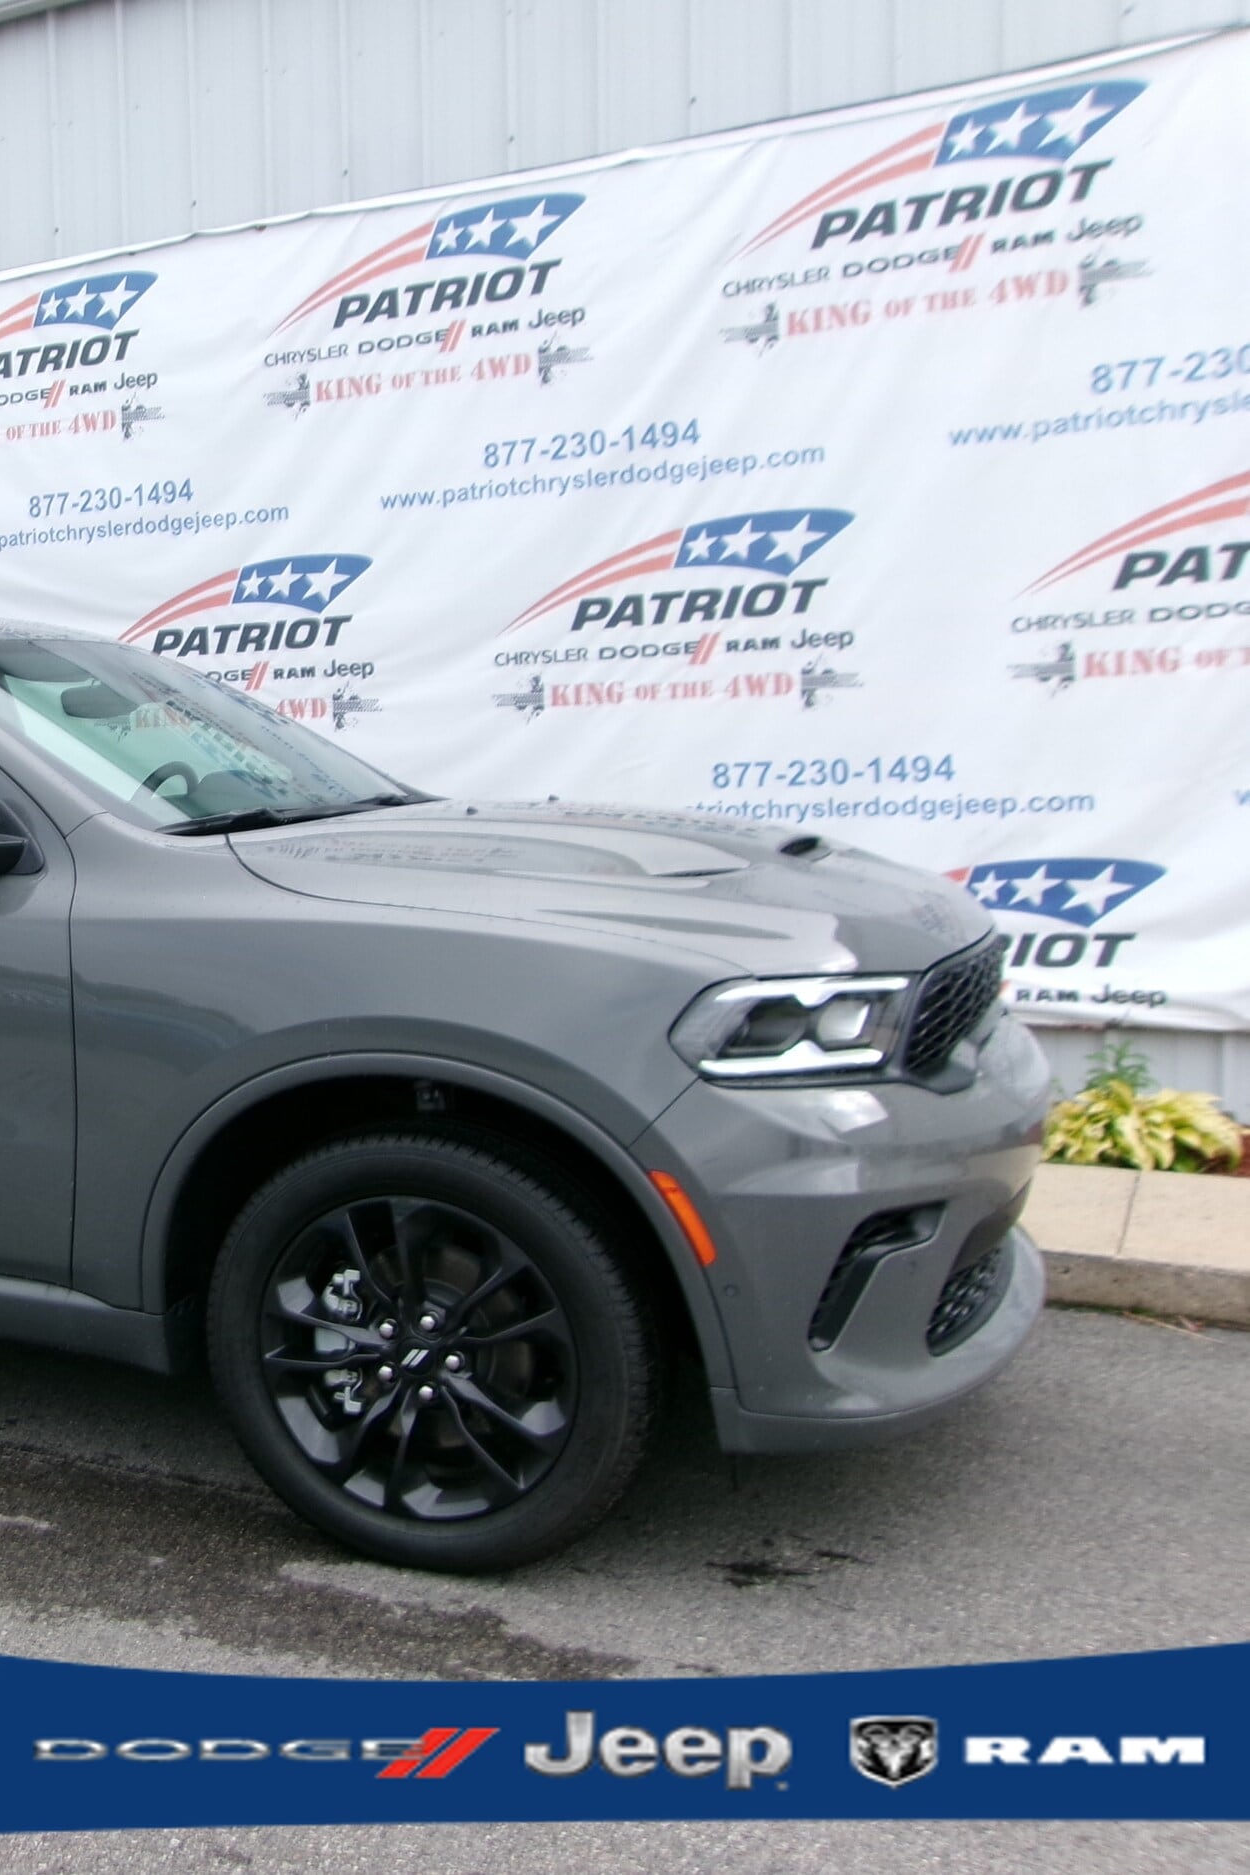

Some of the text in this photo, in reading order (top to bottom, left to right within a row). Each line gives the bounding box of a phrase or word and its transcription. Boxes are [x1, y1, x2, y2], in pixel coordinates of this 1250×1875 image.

[810, 158, 1115, 251] PATRIOT
[722, 213, 1143, 298] CHRYSLER DODGE RAM Jeep
[332, 258, 563, 329] PATRIOT
[786, 270, 1069, 337] KING OF THE 4WD
[264, 306, 586, 368] CHRYSLER DODGE RAM Jeep
[69, 380, 107, 397] RAM
[113, 370, 159, 392] Jeep
[315, 353, 532, 403] KING OF THE 4WD
[1090, 342, 1250, 395] 877-230
[5, 424, 25, 441] OF
[29, 419, 62, 439] THE
[66, 409, 118, 435] 4WD
[483, 418, 701, 469] 877-230-1494
[28, 478, 194, 519] 877-230-1494
[380, 445, 825, 510] www.patriotchryslerdodgejeep.com
[571, 578, 829, 631] PATRIOT
[1011, 601, 1250, 634] CHRYSLER DODG
[153, 614, 352, 657] PATRIOT
[494, 629, 854, 667] CHRYSLER DODGE RAM Jeep
[273, 668, 315, 680] RAM
[324, 659, 374, 679] Jeep
[1083, 647, 1180, 678] KING
[276, 698, 327, 718] 4WD
[551, 672, 794, 708] KING OF THE 4WD
[712, 755, 956, 789] 877-230-1494
[1016, 984, 1168, 1008] RAM Jeep
